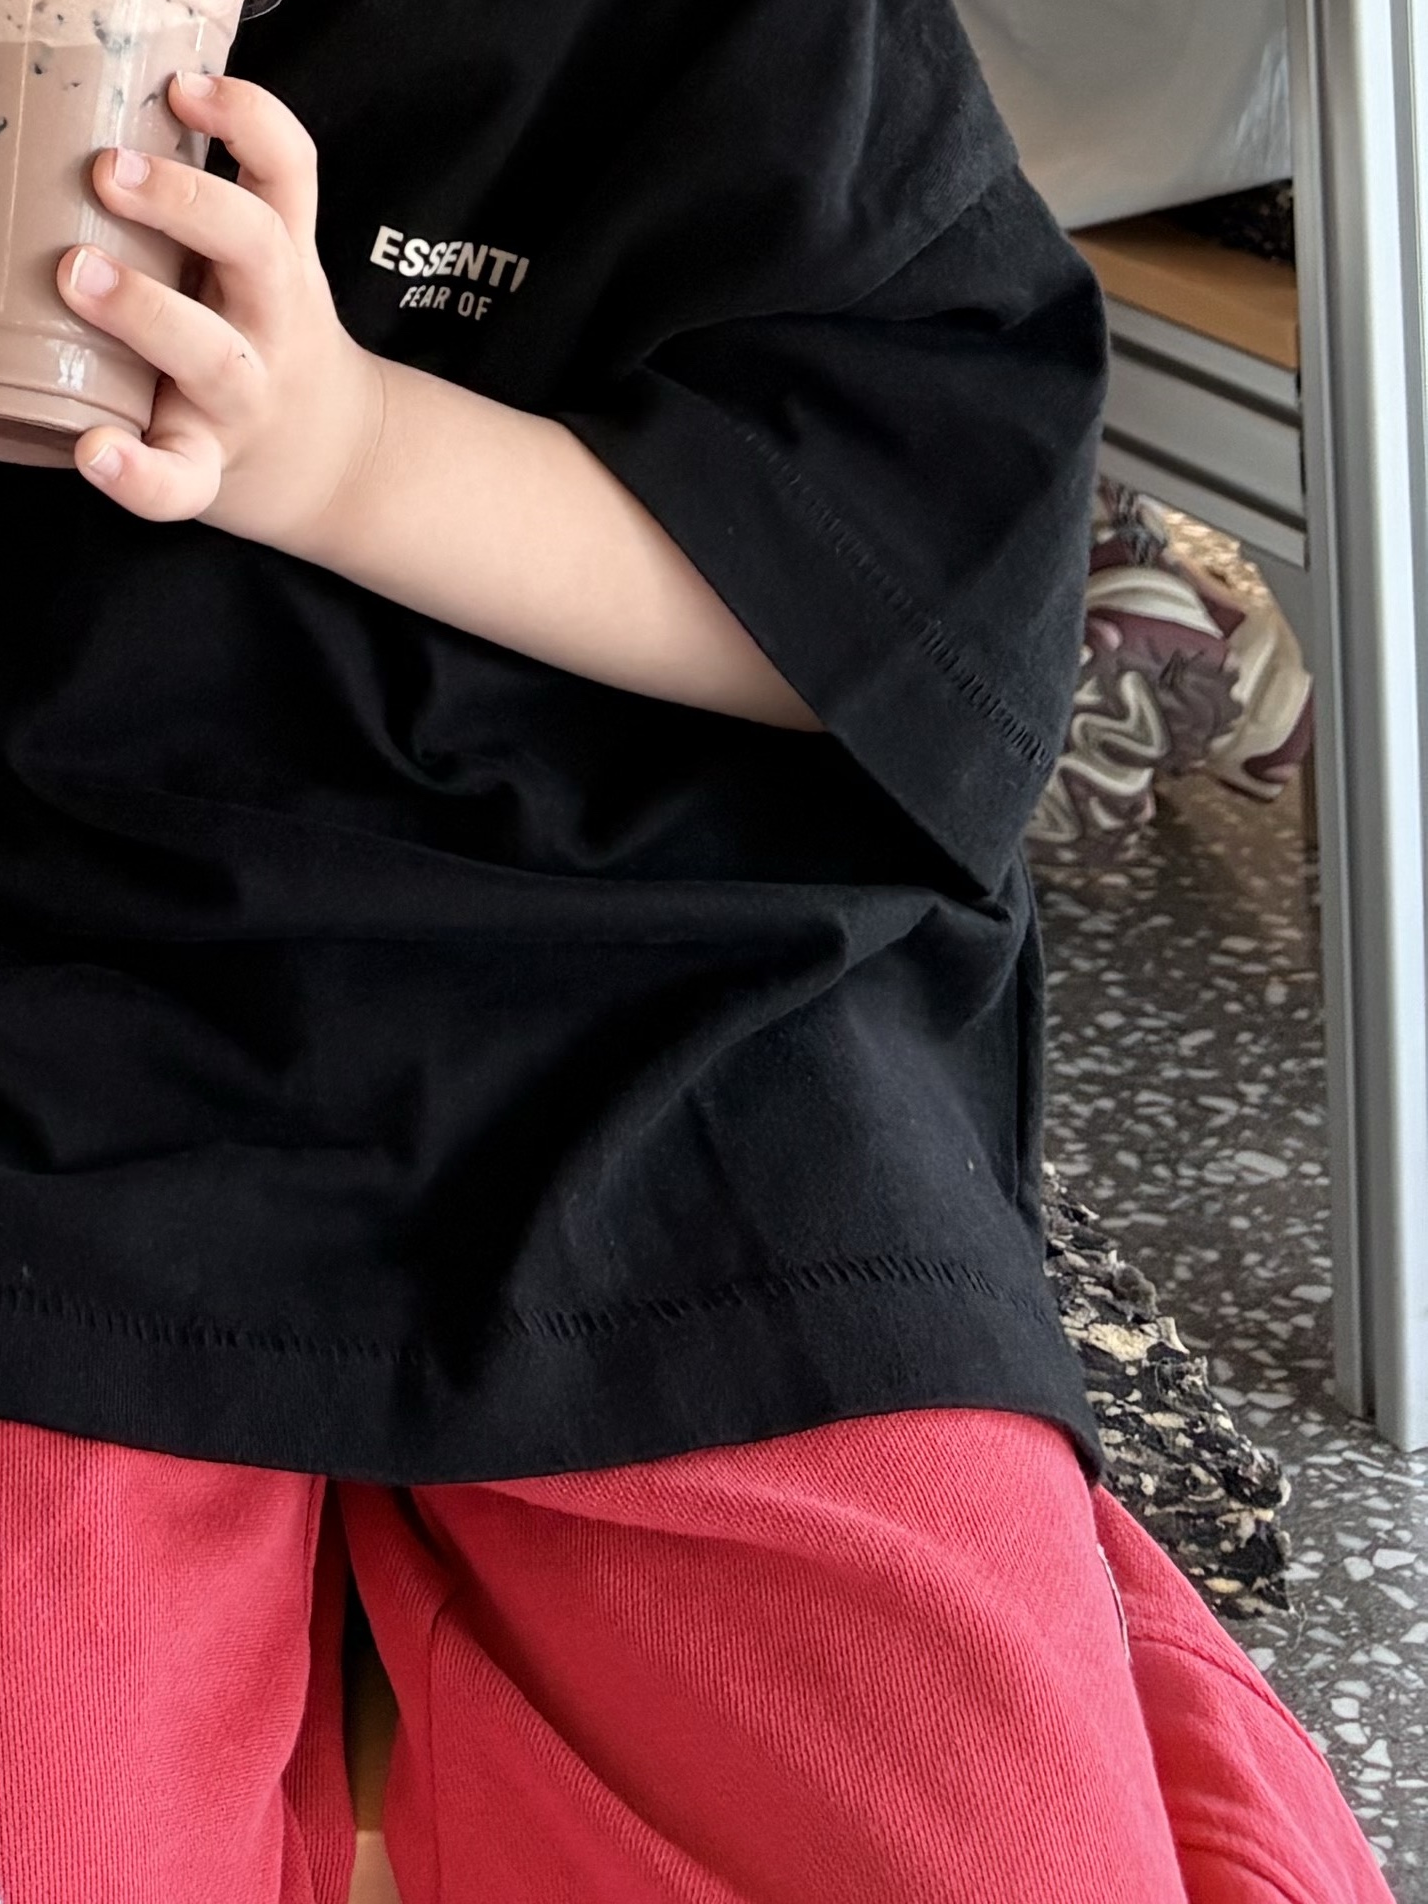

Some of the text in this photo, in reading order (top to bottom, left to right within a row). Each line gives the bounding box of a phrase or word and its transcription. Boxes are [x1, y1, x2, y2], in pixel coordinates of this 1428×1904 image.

[369, 225, 530, 293] ESSENTI
[398, 285, 493, 321] FEAR OF
